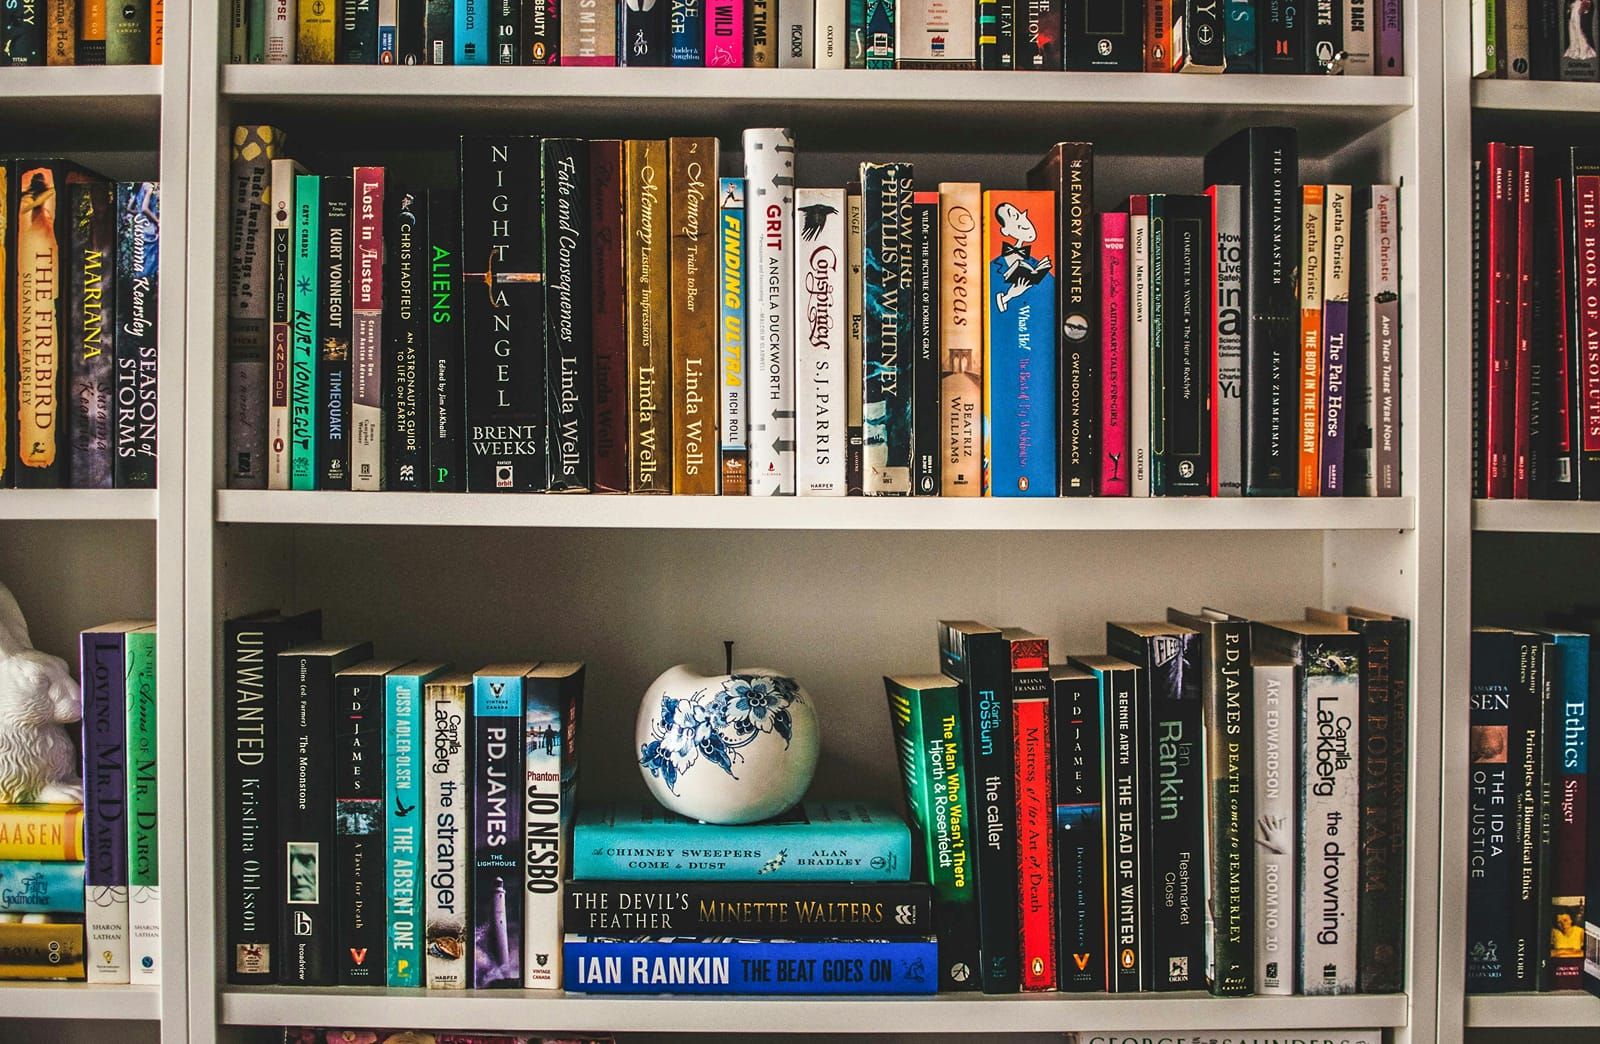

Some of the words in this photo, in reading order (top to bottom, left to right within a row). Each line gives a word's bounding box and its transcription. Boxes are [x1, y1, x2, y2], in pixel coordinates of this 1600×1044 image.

[500, 25, 513, 36] 10
[579, 0, 596, 57] SMITH
[716, 5, 733, 37] WILD
[753, 16, 767, 46] TIME
[1351, 12, 1363, 32] BACK
[792, 25, 802, 58] PICADOR
[558, 156, 575, 196] Fate
[301, 204, 309, 228] CAT'S
[361, 182, 378, 222] Lost
[559, 200, 579, 238] and
[882, 178, 898, 264] PHYLLIS
[1071, 171, 1082, 236] MEMORY
[1583, 191, 1595, 228] THE
[133, 213, 147, 272] Susanna
[301, 231, 309, 258] CRADLE
[329, 228, 342, 260] KURT
[362, 226, 374, 240] in
[400, 224, 412, 260] CHRIS
[767, 204, 781, 250] GRIT
[1306, 214, 1318, 252] Agatha
[35, 248, 52, 301] THE
[358, 245, 377, 302] Austen
[725, 215, 740, 307] FINDING
[882, 268, 896, 287] A.
[948, 206, 975, 326] Overseas
[1071, 242, 1082, 303] PAINTER
[1307, 255, 1319, 300] Christie
[1586, 237, 1597, 287] BOOK
[329, 264, 342, 328] VONNEGUT
[400, 263, 412, 320] HADFIELD
[432, 246, 450, 323] ALIENS
[551, 235, 575, 342] Consequences
[769, 257, 778, 310] ANGELA
[806, 245, 837, 349] Conspiracy
[922, 292, 929, 303] OF
[22, 273, 31, 337] SUSANNA
[84, 249, 103, 360] MARIANA
[124, 276, 151, 337] Kearsley
[1019, 304, 1031, 329] What
[1587, 297, 1597, 318] OF
[407, 332, 414, 344] AN
[852, 314, 861, 340] Bear
[880, 291, 897, 396] WHITNEY
[1019, 332, 1031, 350] Ho!
[1305, 330, 1316, 348] THE
[397, 351, 404, 362] TO
[726, 315, 741, 387] ULTRA
[769, 315, 781, 400] DUCKWORTH
[1305, 351, 1316, 376] BODY
[1330, 333, 1343, 363] The
[22, 339, 31, 405] KEARSLEY
[35, 310, 52, 429] FIREBIRD
[397, 365, 406, 383] LIFE
[406, 347, 415, 415] ASTRONAUT'S
[438, 360, 446, 381] Edited
[438, 383, 445, 392] by
[562, 356, 578, 413] Linda
[1072, 353, 1080, 414] GWENDOLYN
[1305, 379, 1316, 388] IN
[1329, 365, 1342, 392] Pale
[1588, 329, 1600, 437] ABSOLUTES
[329, 371, 342, 440] TIMEQUAKE
[398, 386, 403, 399] ON
[438, 394, 446, 406] Jim
[729, 392, 739, 415] RICH
[1305, 391, 1316, 410] THE
[397, 401, 406, 432] EARTH
[407, 420, 415, 450] GUIDE
[438, 407, 446, 438] Al-Khalili
[473, 426, 536, 440] BRENT
[730, 419, 739, 442] ROLL
[951, 396, 961, 464] WILLIAMS
[964, 403, 973, 457] BEATRIZ
[1304, 412, 1316, 454] LIBRARY
[1328, 396, 1341, 437] Horse
[473, 441, 536, 455] WEEKS
[562, 420, 579, 475] Wells
[1071, 418, 1080, 464] WOMACK
[236, 631, 264, 766] UNWANTED
[396, 686, 410, 716] JUSSI
[1120, 692, 1128, 730] RENNIE
[1267, 679, 1280, 705] ÅKE
[300, 736, 308, 754] The
[943, 716, 954, 739] The
[1564, 701, 1584, 768] Ethics
[396, 720, 411, 789] ADLER-OLSEN
[930, 740, 945, 780] Hjorth
[945, 743, 956, 770] Man
[1120, 733, 1129, 764] AIRTH
[1267, 710, 1279, 798] EDWARDSON
[1524, 730, 1535, 787] Principles
[299, 757, 308, 810] Moonstone
[528, 771, 559, 781] Phantom
[934, 783, 946, 793] &
[948, 774, 960, 802] Who
[1159, 720, 1182, 820] Rankin
[1472, 771, 1486, 796] OF
[442, 782, 456, 807] the
[528, 785, 558, 814] JO
[1491, 771, 1504, 808] THE
[1525, 790, 1533, 803] of
[1562, 780, 1577, 824] Singer
[242, 778, 259, 854] Kristina
[935, 796, 950, 868] Rosenfeldt
[950, 804, 964, 848] Wasn't
[394, 826, 412, 856] THE
[1472, 802, 1484, 878] JUSTICE
[1491, 814, 1504, 857] IDEA
[1523, 806, 1534, 865] Biomedical
[434, 813, 458, 913] stranger
[528, 822, 558, 894] NESBO
[953, 850, 966, 887] There
[242, 861, 261, 931] Ohlsson
[394, 859, 413, 914] ABSENT
[573, 893, 608, 909] THE
[619, 893, 689, 909] DEVIL'S
[1164, 872, 1175, 907] Close
[1179, 852, 1190, 925] Fleshmarket
[1521, 868, 1531, 901] Ethics
[590, 913, 672, 928] FEATHER
[699, 900, 788, 922] MINETTE
[796, 901, 883, 922] WALTERS
[394, 921, 414, 950] ONE
[578, 957, 621, 983] IAN
[632, 957, 729, 983] RANKIN
[741, 960, 770, 981] THE
[777, 960, 814, 981] BEAT
[824, 960, 863, 981] GOES
[870, 960, 892, 981] ON
